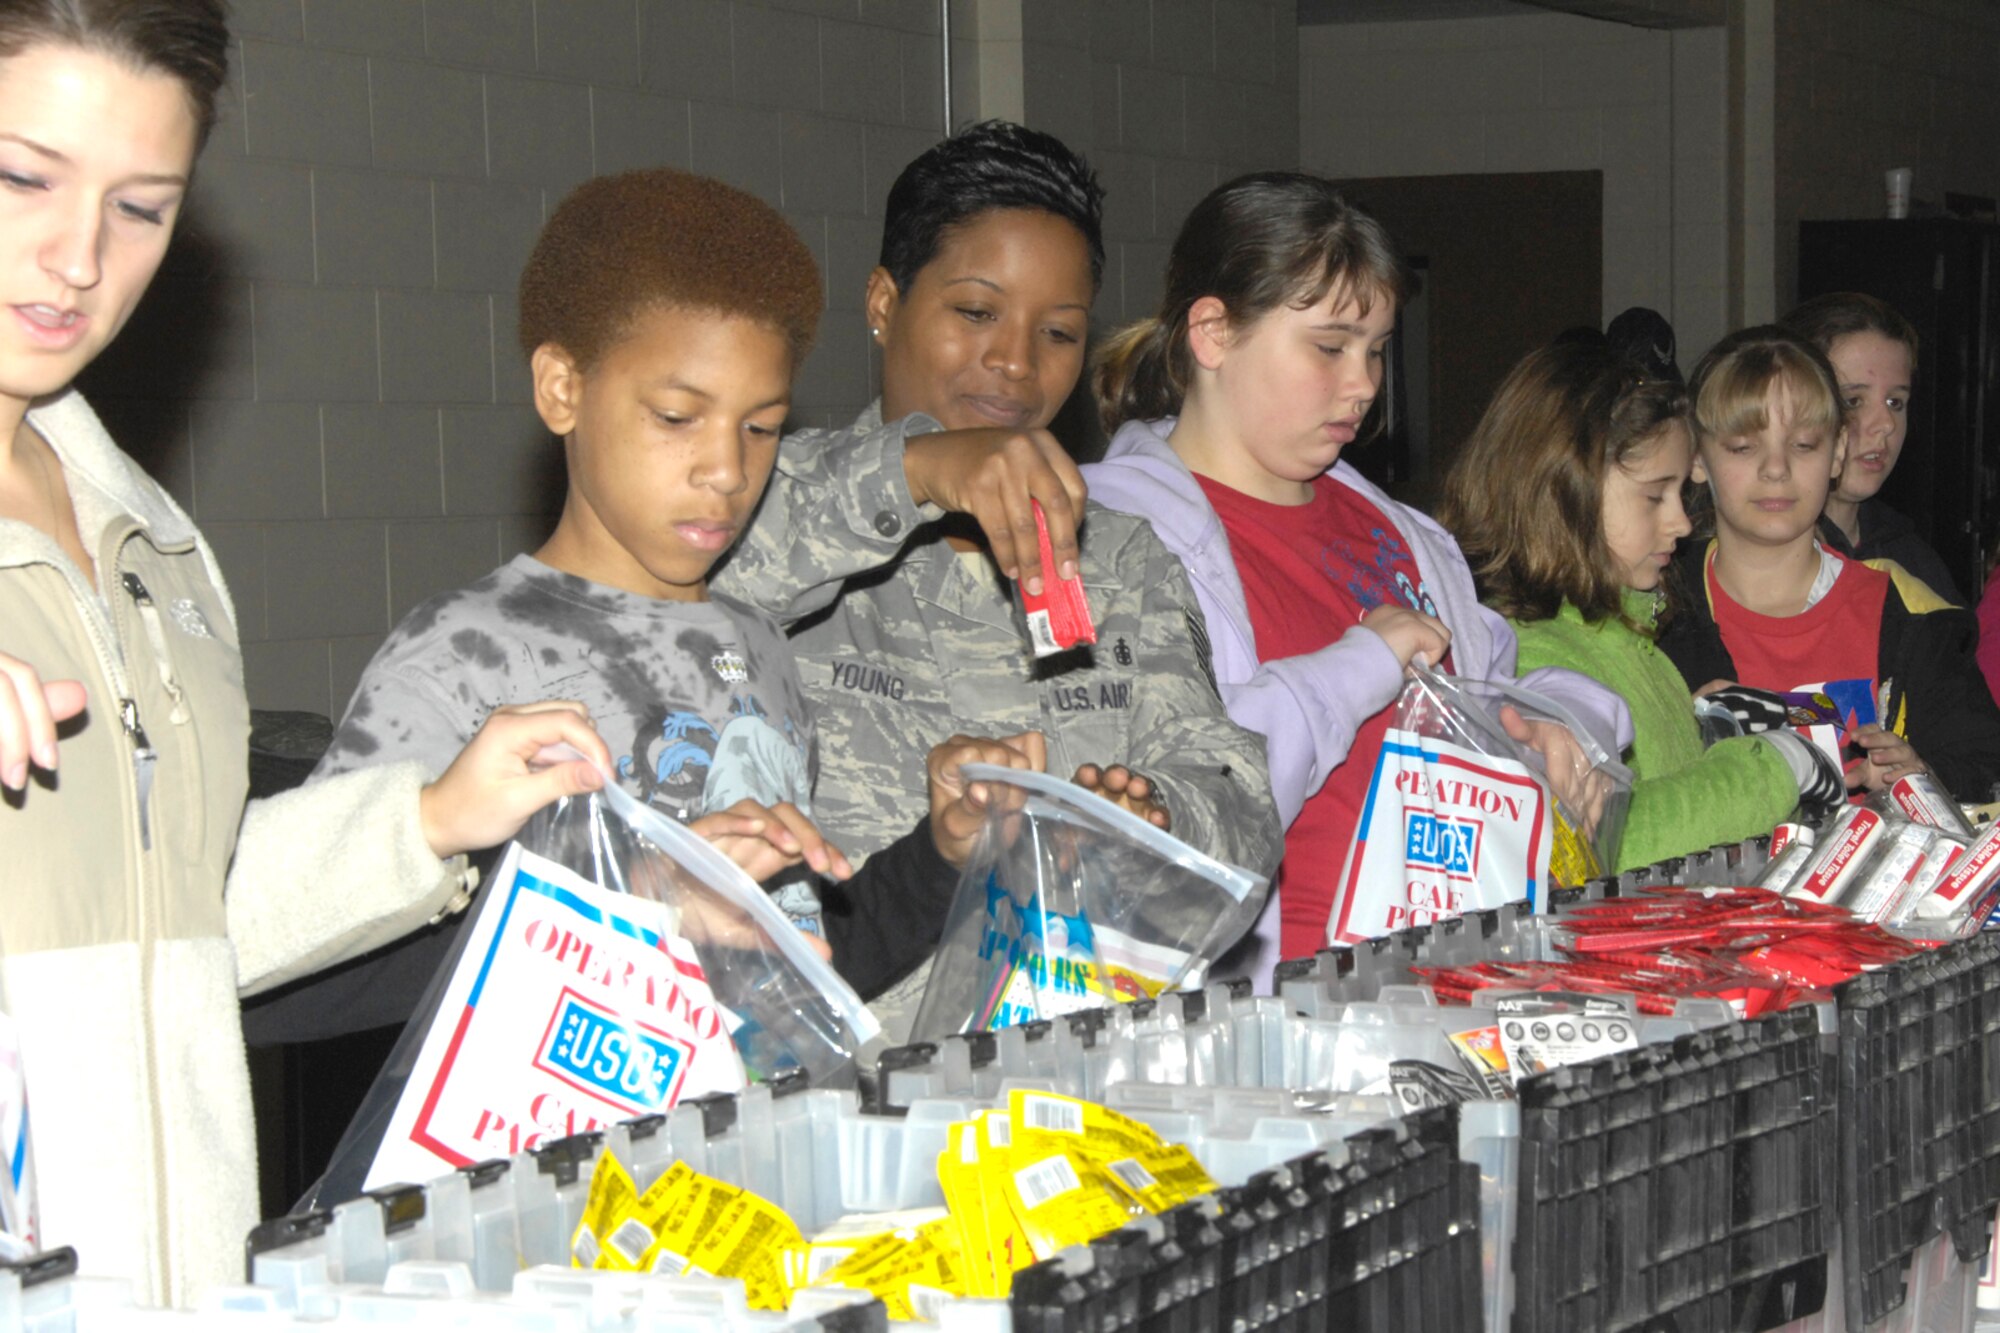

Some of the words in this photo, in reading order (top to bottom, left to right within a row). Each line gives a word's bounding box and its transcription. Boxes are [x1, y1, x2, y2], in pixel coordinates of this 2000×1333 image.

[831, 660, 905, 701] YOUNG
[1054, 685, 1096, 711] U.S.
[1848, 818, 1872, 845] Travel
[1834, 841, 1855, 865] Toilet
[1817, 861, 1841, 887] Tissue
[1949, 861, 1978, 891] Tissue
[524, 918, 730, 1045] OPERATIO
[568, 1017, 658, 1095] USO
